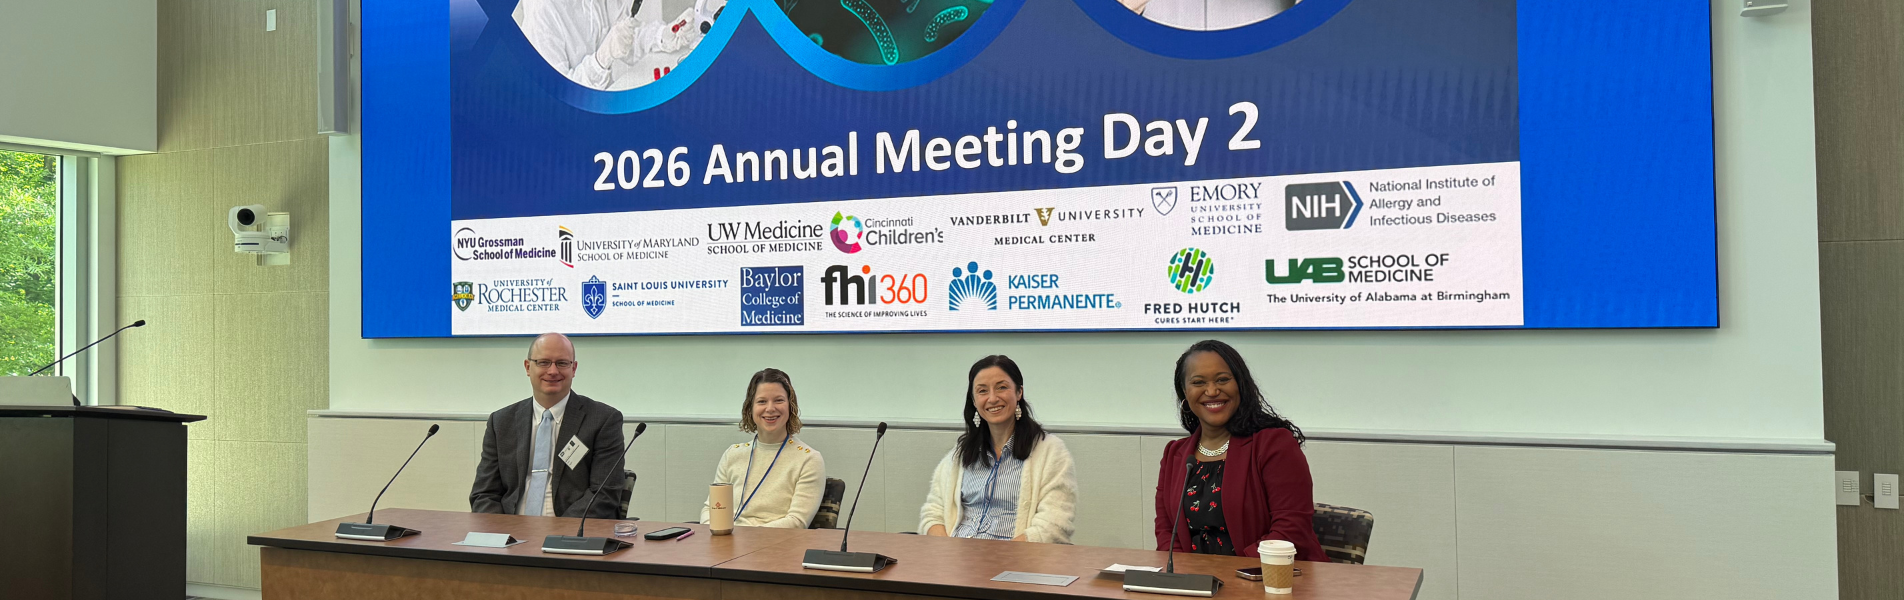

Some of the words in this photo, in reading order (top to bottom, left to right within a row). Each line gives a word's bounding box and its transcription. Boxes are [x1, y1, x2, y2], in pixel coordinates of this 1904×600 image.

[593, 146, 691, 192] 2026
[702, 131, 858, 185] Annual
[875, 120, 1085, 174] Meeting
[1102, 111, 1208, 166] Day
[1227, 102, 1262, 150] 2
[1369, 179, 1422, 193] National
[1425, 177, 1479, 190] Institute
[1482, 175, 1496, 187] of
[1190, 182, 1262, 202] EMORY
[1191, 203, 1262, 213] UNIVERSITY
[1291, 194, 1341, 219] NIH
[1369, 198, 1413, 211] Allergy
[1416, 196, 1441, 208] and
[865, 216, 913, 228] Cincinnati
[950, 213, 1031, 226] VANDERBILT
[1058, 208, 1145, 221] UNIVERSITY
[1191, 215, 1241, 223] SCHOOL
[1369, 213, 1433, 226] Infectious
[1436, 211, 1496, 224] Diseases
[707, 222, 742, 241] UW
[744, 220, 824, 240] Medicine
[1191, 224, 1262, 236] MEDICINE
[457, 237, 476, 249] NYU
[478, 237, 524, 248] Grossman
[577, 240, 633, 251] UNIVERSITY
[634, 239, 642, 249] of
[642, 237, 700, 248] MARYLAND
[994, 235, 1045, 245] MEDICAL
[1049, 233, 1096, 243] CENTER
[473, 249, 504, 260] School
[504, 249, 514, 259] of
[514, 248, 556, 258] Medicine
[707, 244, 749, 255] SCHOOL
[752, 243, 766, 253] OF
[768, 241, 823, 252] MEDICINE
[577, 253, 610, 262] SCHOOL
[612, 252, 624, 260] OF
[626, 250, 668, 260] MEDICINE
[1265, 257, 1345, 284] UAB
[1348, 255, 1420, 269] SCHOOL
[1424, 254, 1450, 267] OF
[1348, 269, 1434, 283] MEDICINE
[493, 279, 544, 287] UNIVERSITY
[612, 281, 638, 291] SAINT
[641, 281, 668, 290] LOUIS
[670, 280, 728, 289] UNIVERSITY
[742, 268, 801, 290] Baylor
[1008, 274, 1059, 289] KAISER
[478, 283, 568, 305] ROCHESTER
[742, 293, 785, 308] College
[787, 292, 800, 304] of
[1267, 294, 1288, 303] The
[1290, 293, 1346, 305] University
[1350, 292, 1362, 302] of
[1365, 292, 1417, 302] Alabama
[1420, 292, 1433, 301] at
[1437, 290, 1510, 303] Birmingham
[488, 303, 524, 312] MEDICAL
[527, 302, 560, 311] CENTER
[1144, 303, 1182, 314] FRED
[1188, 302, 1240, 313] HUTCH
[742, 311, 802, 324] Medicine
